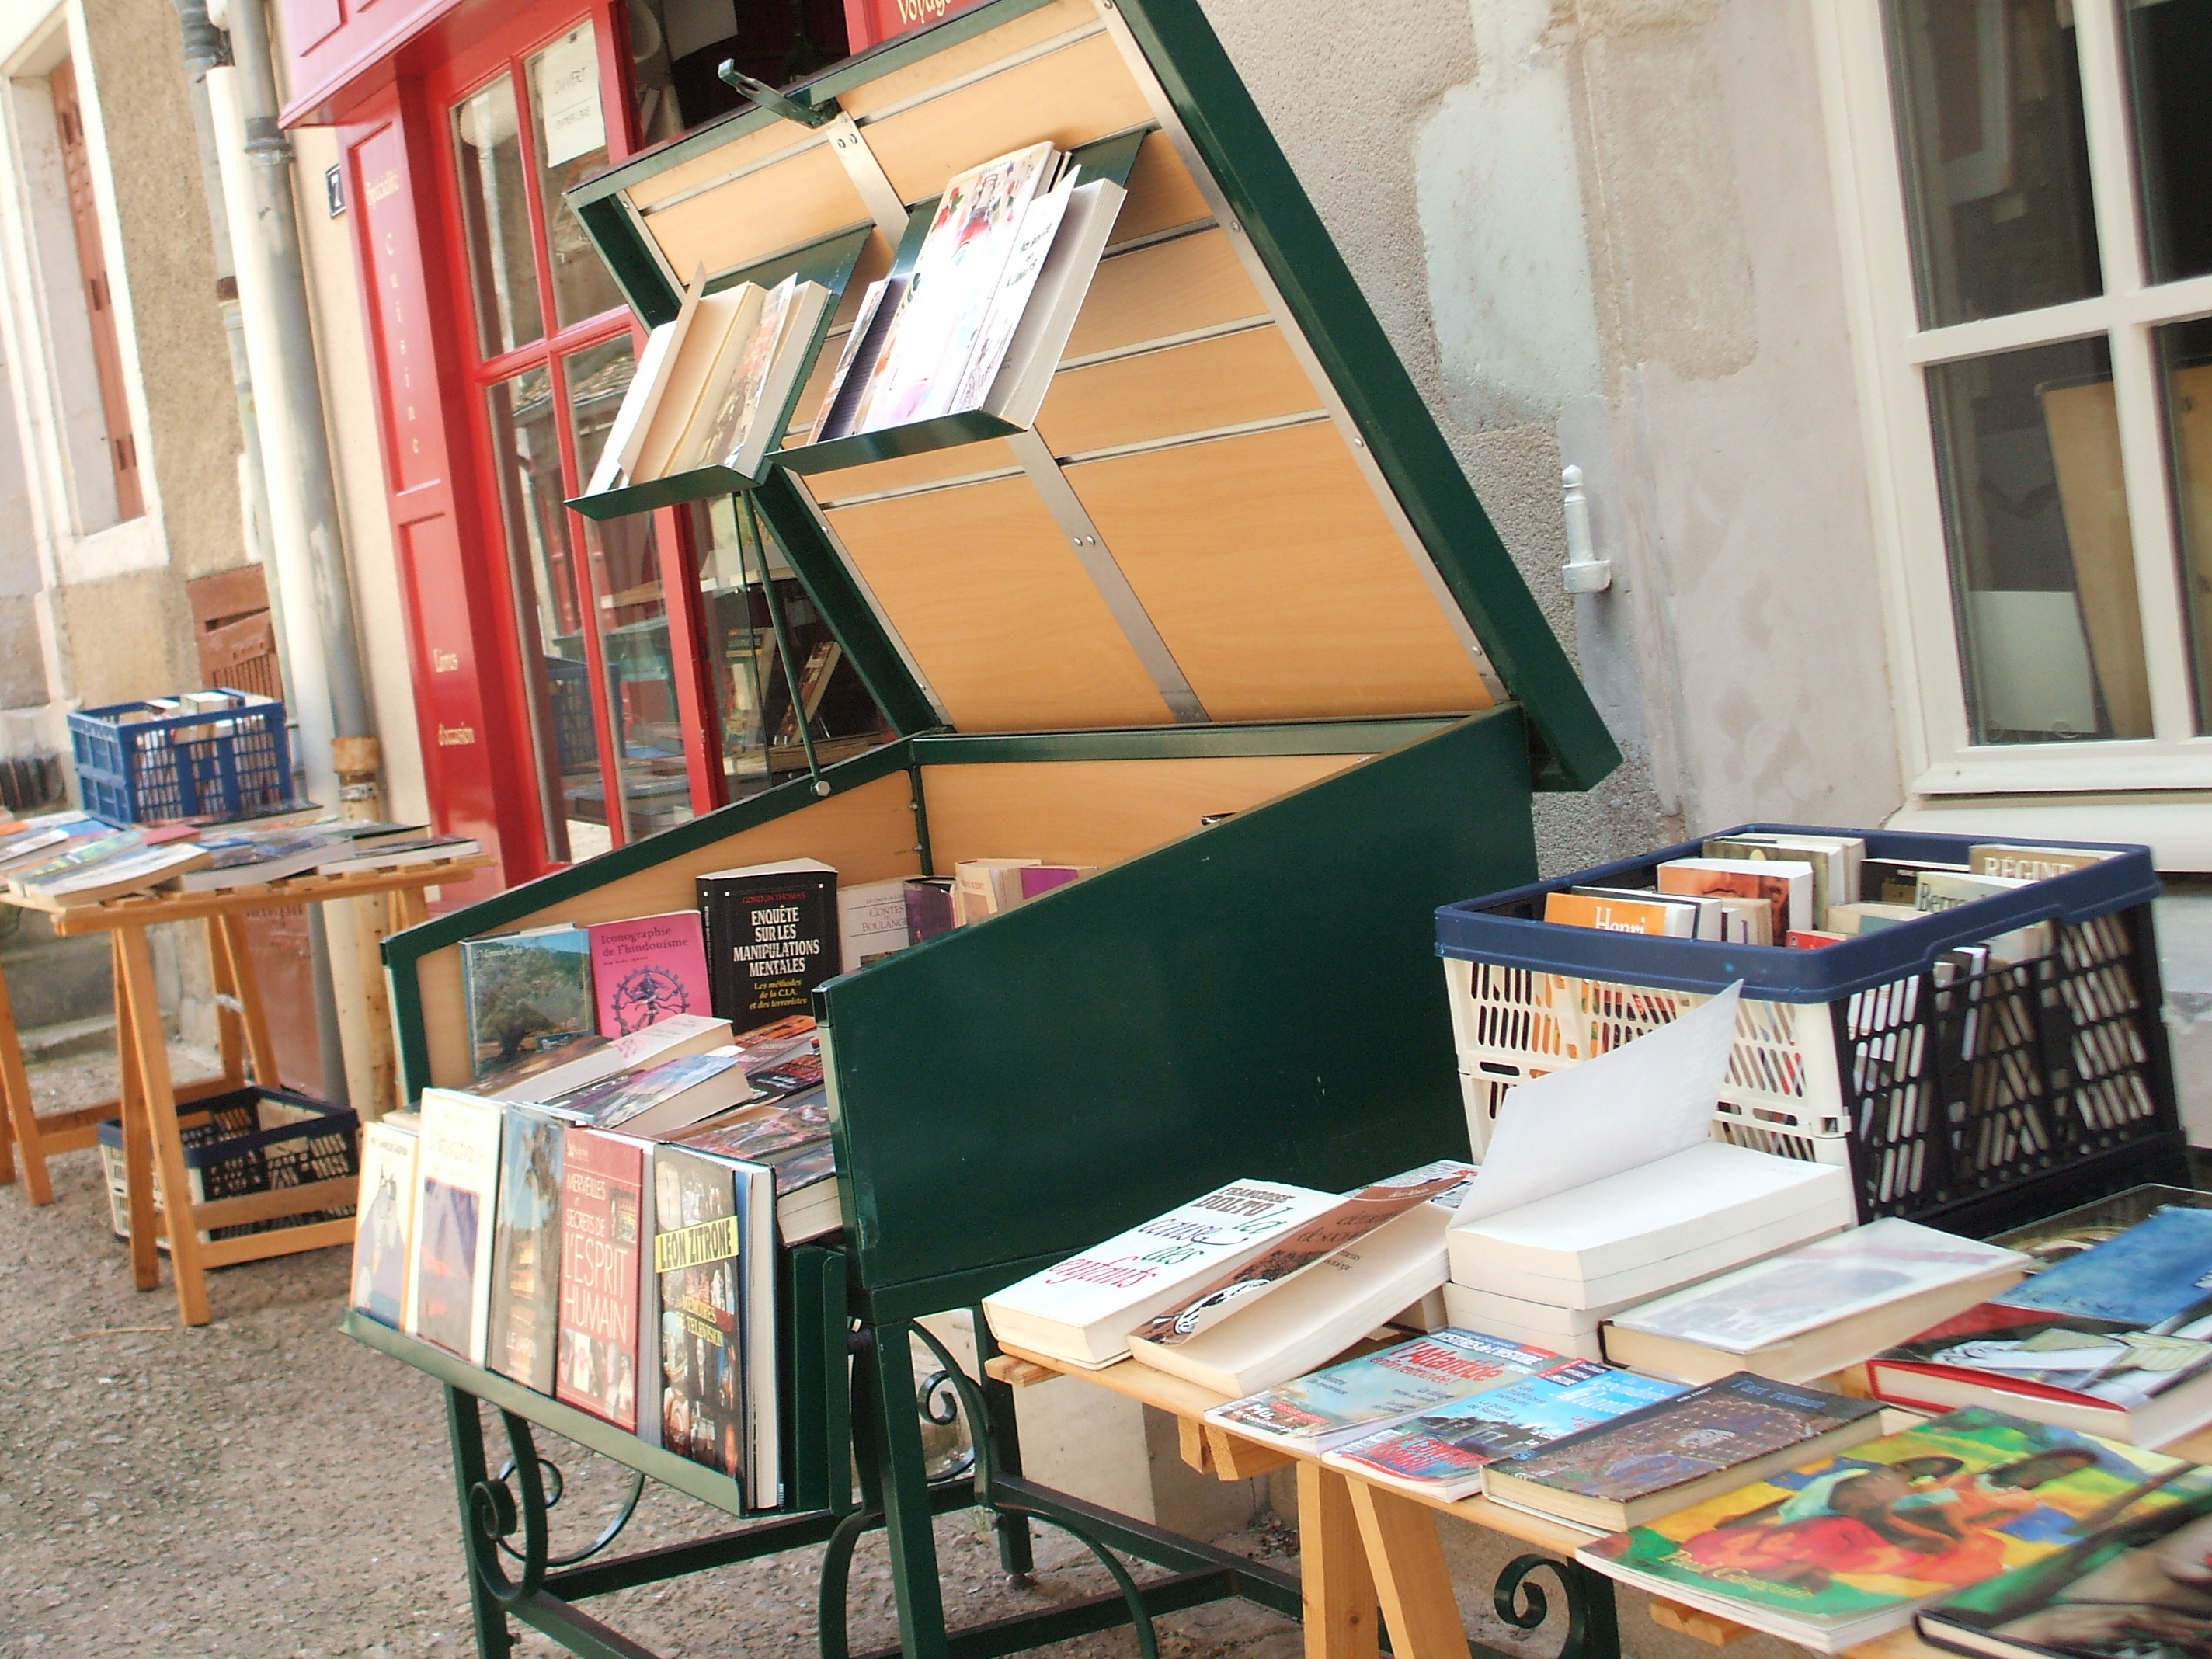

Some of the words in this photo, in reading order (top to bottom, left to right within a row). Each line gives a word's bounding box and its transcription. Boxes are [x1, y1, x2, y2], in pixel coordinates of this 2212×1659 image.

[331, 173, 343, 207] 7
[433, 648, 458, 673] Livres
[743, 894, 776, 905] GORDON
[751, 905, 800, 926] ENQUÊTE
[601, 927, 671, 944] Iconographie
[754, 927, 776, 943] SUR
[777, 923, 797, 940] LES
[602, 948, 615, 958] de
[617, 937, 688, 955] l'hindouisme
[732, 939, 820, 962] MANIPULATIONS
[749, 957, 806, 977] MENTALES
[754, 982, 767, 990] Les
[768, 978, 802, 989] méthodes
[757, 1000, 770, 1008] des
[770, 996, 808, 1007] terroristes
[566, 1172, 607, 1202] MERVEILLES
[1191, 1195, 1275, 1217] DOLTO
[565, 1208, 595, 1236] SECRETS
[595, 1218, 606, 1238] DE
[1230, 1205, 1295, 1234] la
[1137, 1218, 1249, 1246] cause
[660, 1232, 686, 1270] LEON
[687, 1219, 732, 1262] ZITRONE
[1140, 1240, 1205, 1264] des
[565, 1232, 628, 1299] L'ESPRIT
[1045, 1255, 1159, 1289] enfants
[563, 1282, 628, 1344] HUMAIN
[1370, 1357, 1401, 1371] enfin
[1389, 1341, 1505, 1382] l'Atlantide
[1657, 1549, 1723, 1574] Paul
[1711, 1567, 1817, 1601] Gauguin
